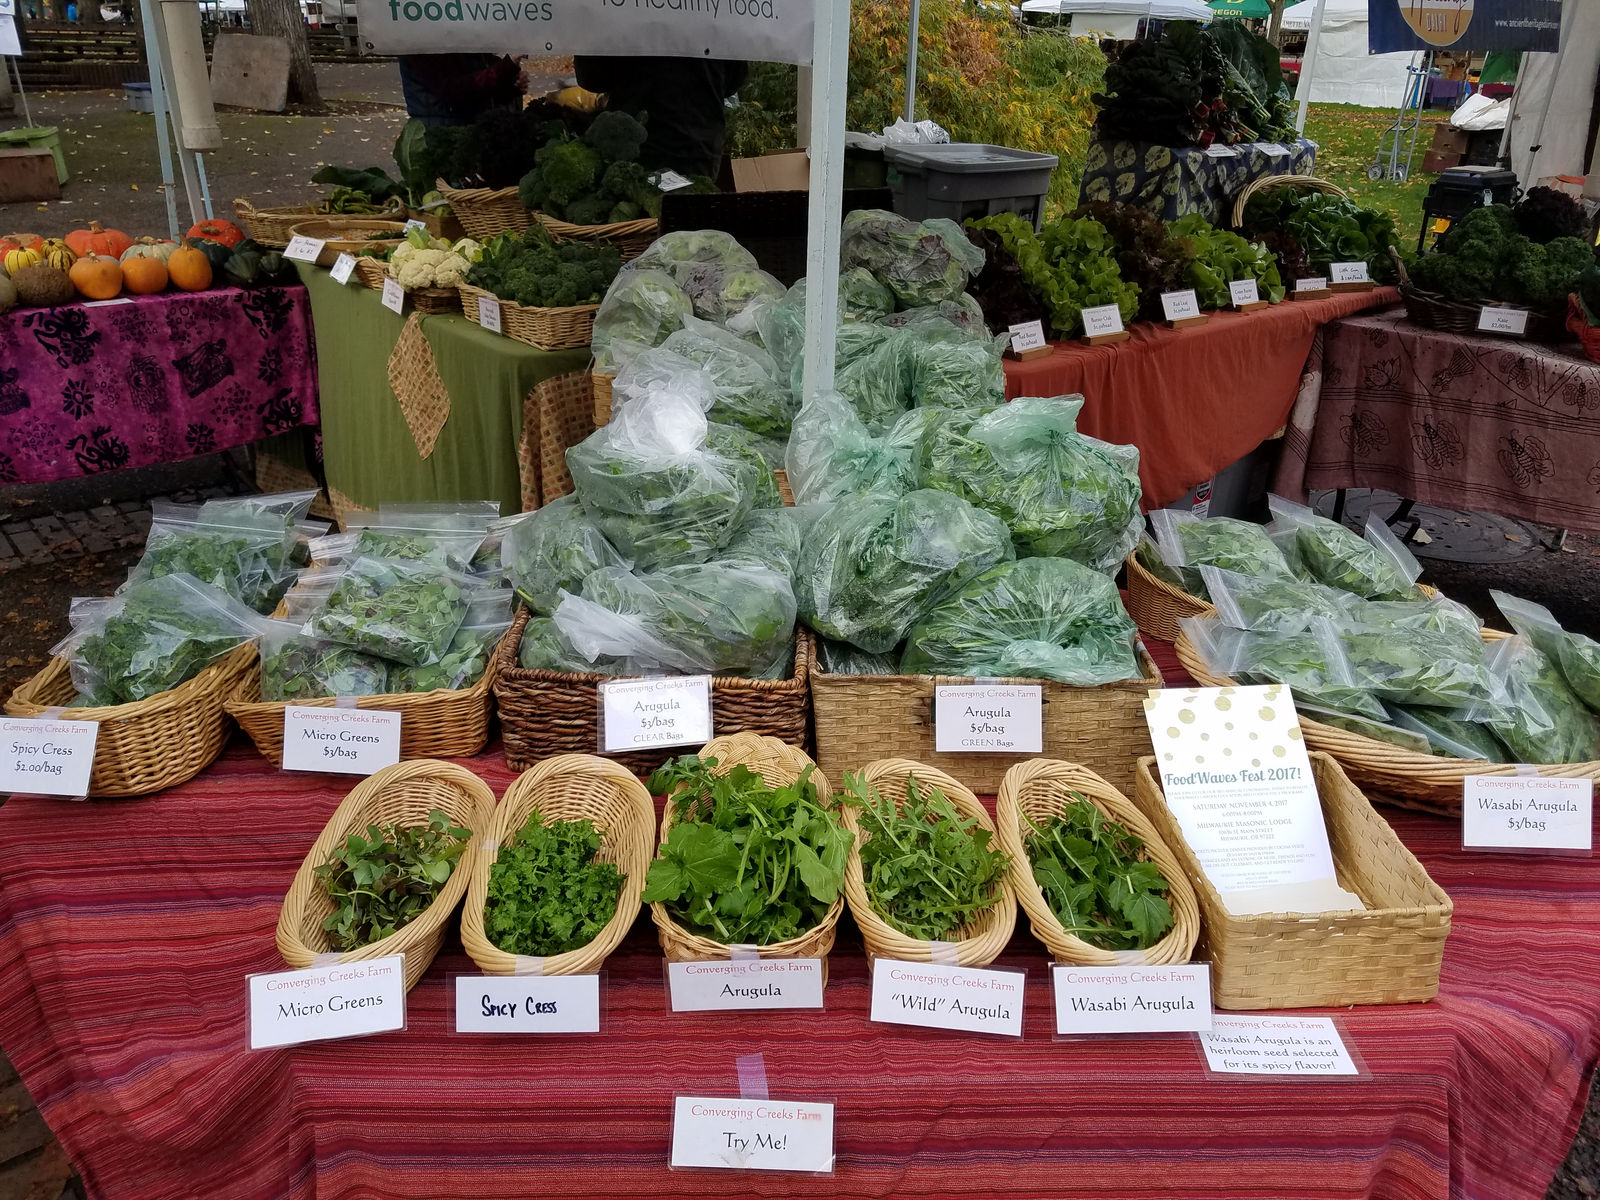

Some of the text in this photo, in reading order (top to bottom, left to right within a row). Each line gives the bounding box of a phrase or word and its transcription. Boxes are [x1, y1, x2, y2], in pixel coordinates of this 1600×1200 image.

[389, 0, 552, 21] foodwaves
[608, 680, 704, 694] Converging Creeks Farm
[939, 689, 1037, 698] Converging Creeks Farm
[633, 699, 680, 713] Arugula
[963, 706, 1011, 719] Arugula
[292, 710, 391, 724] Converging Creeks Farm
[641, 716, 675, 729] $3/bag
[3, 723, 88, 734] Converging Creeks Farm
[970, 722, 1005, 734] $5/bag
[302, 728, 380, 743] Micro Greens
[633, 732, 684, 743] CLEAR Bags
[11, 742, 73, 756] Spicy Cress
[961, 739, 1014, 748] GREEN Bags
[323, 746, 358, 759] $3/bag
[15, 761, 62, 775] $2.00/bag
[1164, 767, 1302, 786] FoodWaves Fest 2017!
[1476, 779, 1580, 790] Converging Creeks Farm
[1192, 803, 1227, 811] SATURDAY
[1229, 800, 1267, 809] NOVEMBER
[1478, 798, 1578, 814] Wasabi Arugula
[1196, 821, 1234, 829] MILWAUKIE
[1235, 819, 1268, 827] MASONIC
[1508, 817, 1546, 831] $3/bag
[686, 962, 812, 975] Converging Creeks Farm
[266, 965, 392, 991] Converging Creeks Farm
[890, 969, 1015, 991] Converging Creeks Farm
[1066, 971, 1195, 985] Converging Creeks Farm
[719, 983, 782, 1000] Arugula
[276, 995, 383, 1021] Micro Greens
[948, 999, 1010, 1020] Arugula
[1071, 995, 1195, 1014] Wasabi Arugula
[1213, 1020, 1325, 1030] onverging Creeks Farm
[1207, 1033, 1250, 1044] Wasabi
[1253, 1035, 1301, 1046] Arugula
[1304, 1037, 1315, 1045] is
[1209, 1046, 1339, 1057] heirloom seed selected
[1223, 1059, 1336, 1070] for its spicy flavor!
[691, 1105, 822, 1121] Converging Creeks Farm
[722, 1132, 787, 1152] Try Me!
